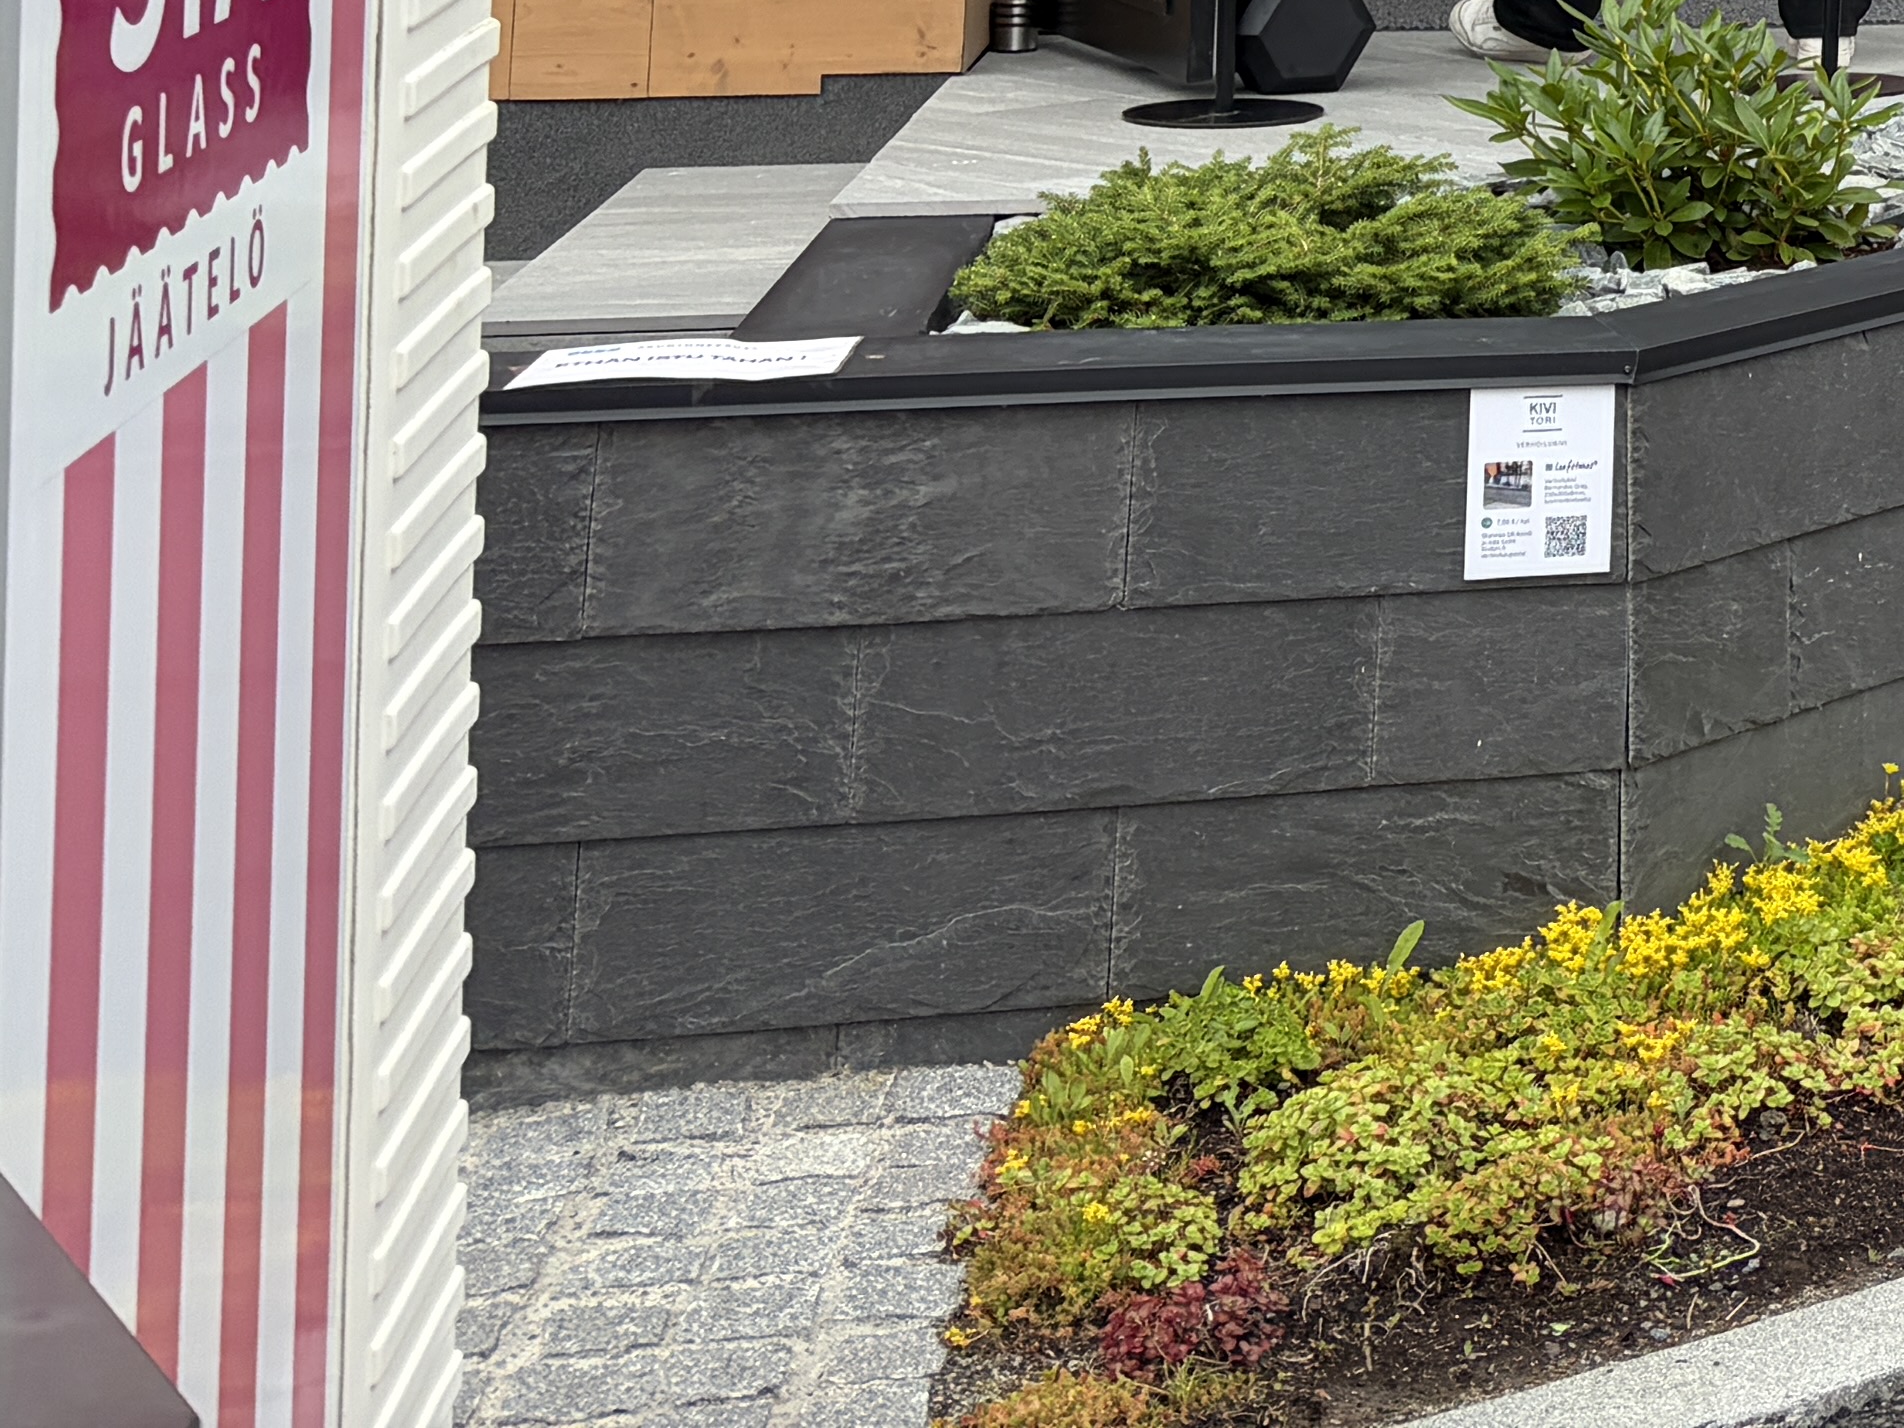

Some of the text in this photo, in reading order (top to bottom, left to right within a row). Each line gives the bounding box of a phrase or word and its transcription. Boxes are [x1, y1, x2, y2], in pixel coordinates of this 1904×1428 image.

[121, 44, 263, 193] GLASS
[103, 204, 267, 397] JÄÄTELÖ
[1529, 402, 1557, 415] KIVI
[1530, 416, 1556, 426] TORI
